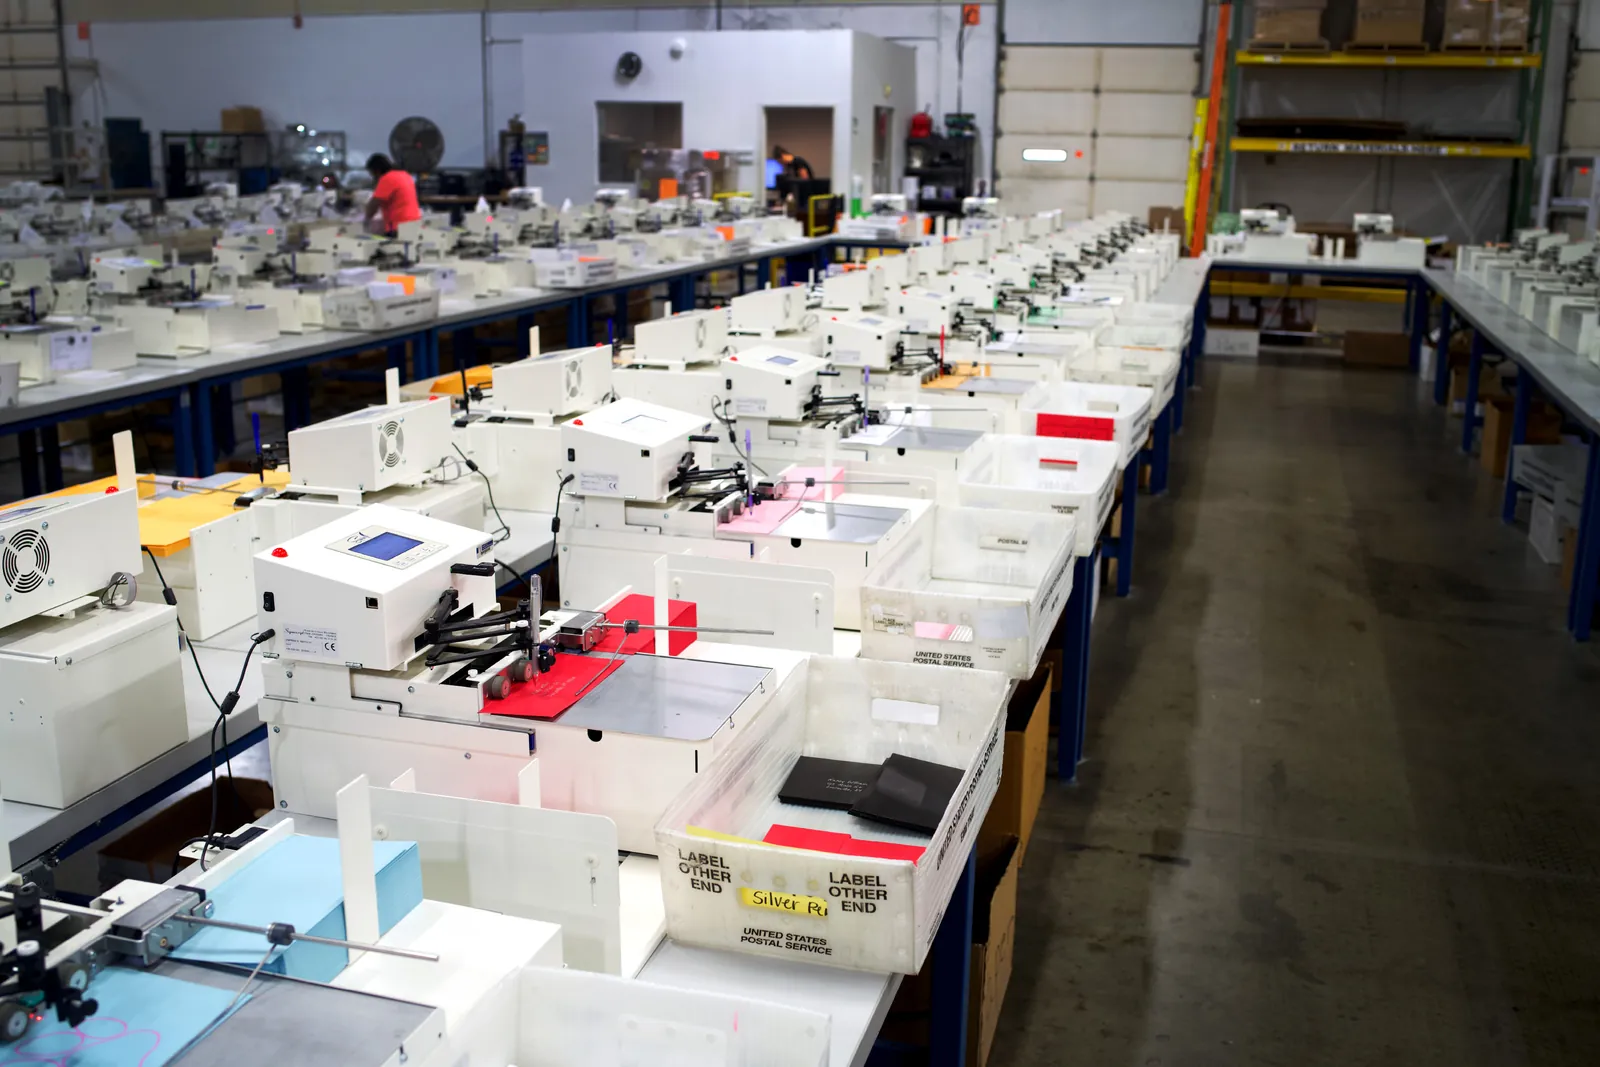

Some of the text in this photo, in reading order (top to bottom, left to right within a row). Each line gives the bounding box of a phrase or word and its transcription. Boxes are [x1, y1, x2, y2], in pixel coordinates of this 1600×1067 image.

[913, 657, 975, 669] POSTAL SERVICE
[915, 651, 943, 659] UNITED
[943, 653, 972, 662] STATES
[678, 848, 730, 870] LABEL
[678, 862, 732, 883] OTHER
[829, 872, 887, 887] LABEL
[690, 878, 722, 894] END
[828, 886, 888, 901] OTHER
[753, 890, 800, 910] Silver
[841, 900, 877, 914] END
[743, 927, 827, 945] UNITED STATES
[740, 936, 833, 955] POSTAL SERVICE
